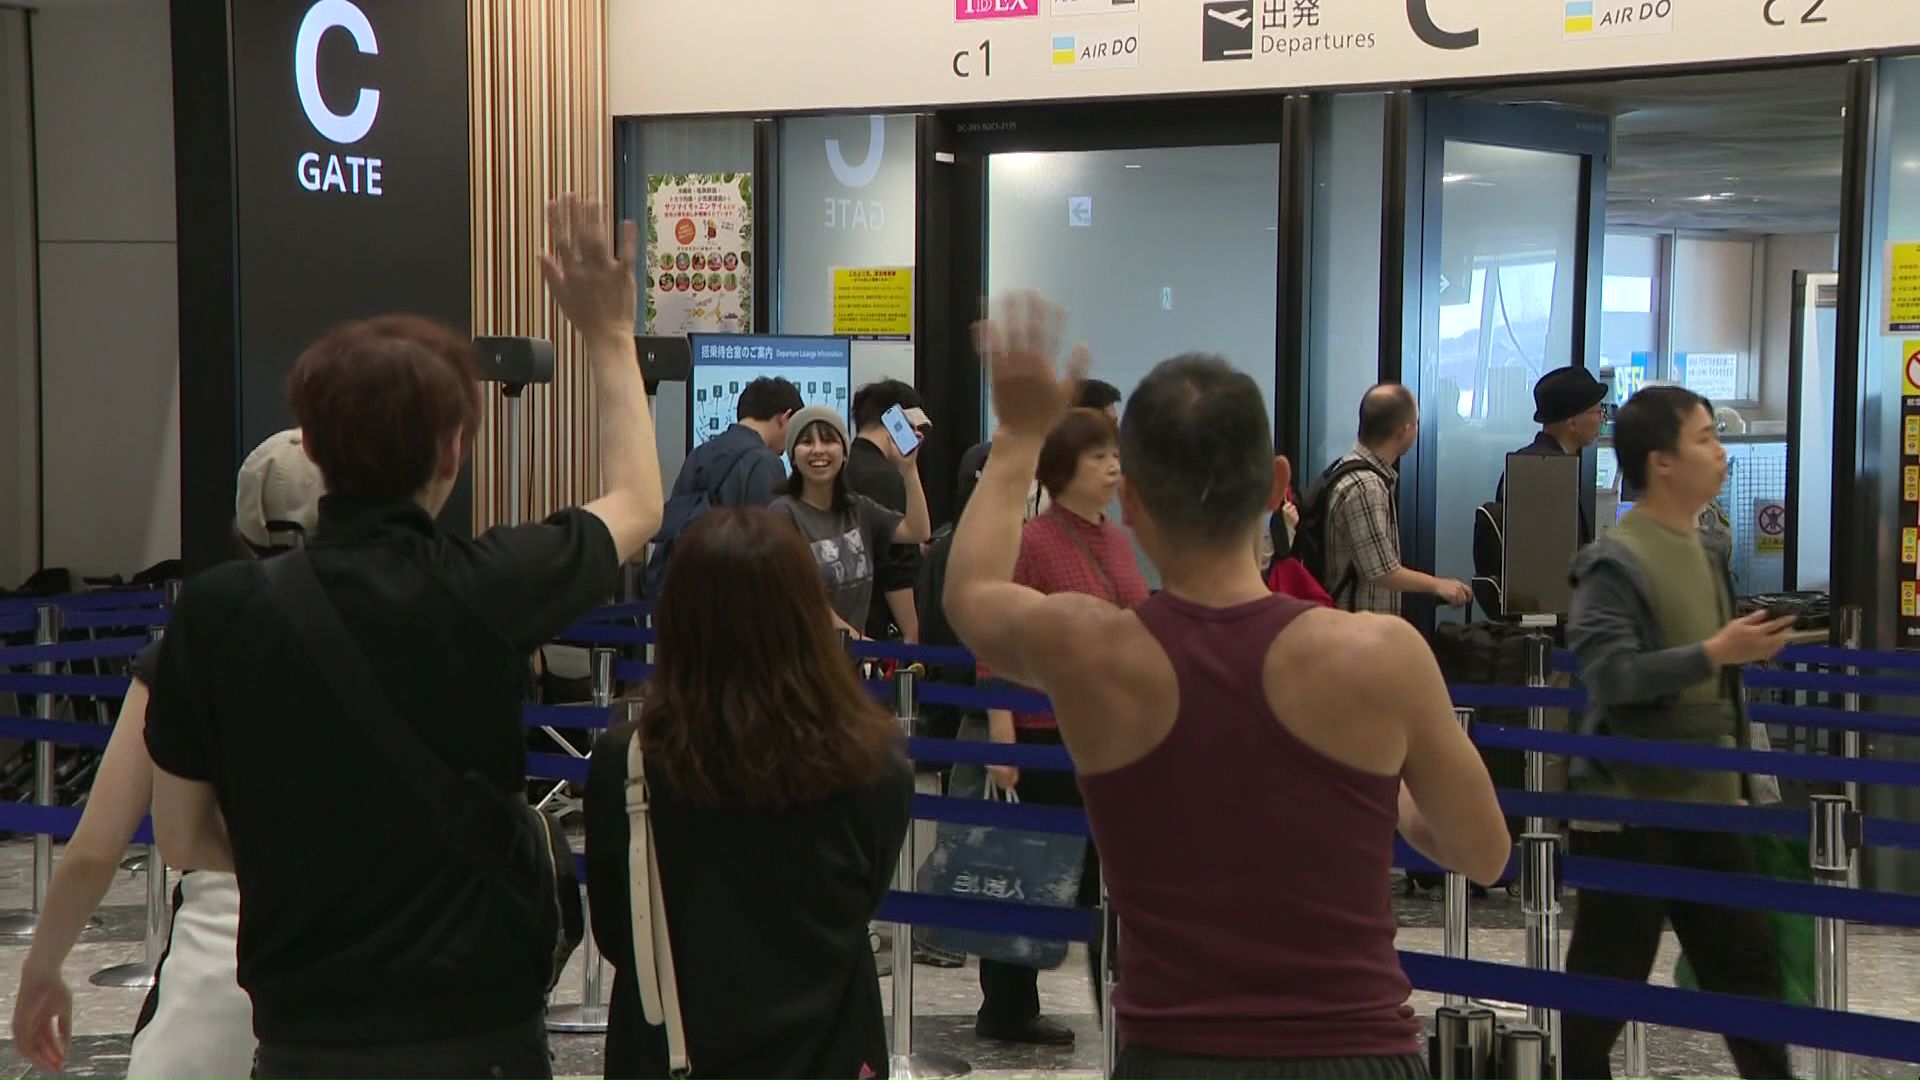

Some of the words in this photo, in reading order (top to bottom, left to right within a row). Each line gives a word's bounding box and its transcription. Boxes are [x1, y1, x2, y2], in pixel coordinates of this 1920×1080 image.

[1262, 0, 1320, 29] 出発
[1600, 7, 1634, 26] AIR
[1639, 0, 1671, 20] DO
[1080, 42, 1107, 60] AIR
[1112, 36, 1137, 55] DO
[1261, 31, 1375, 56] Departures
[295, 0, 381, 144] C
[298, 152, 383, 196] GATE
